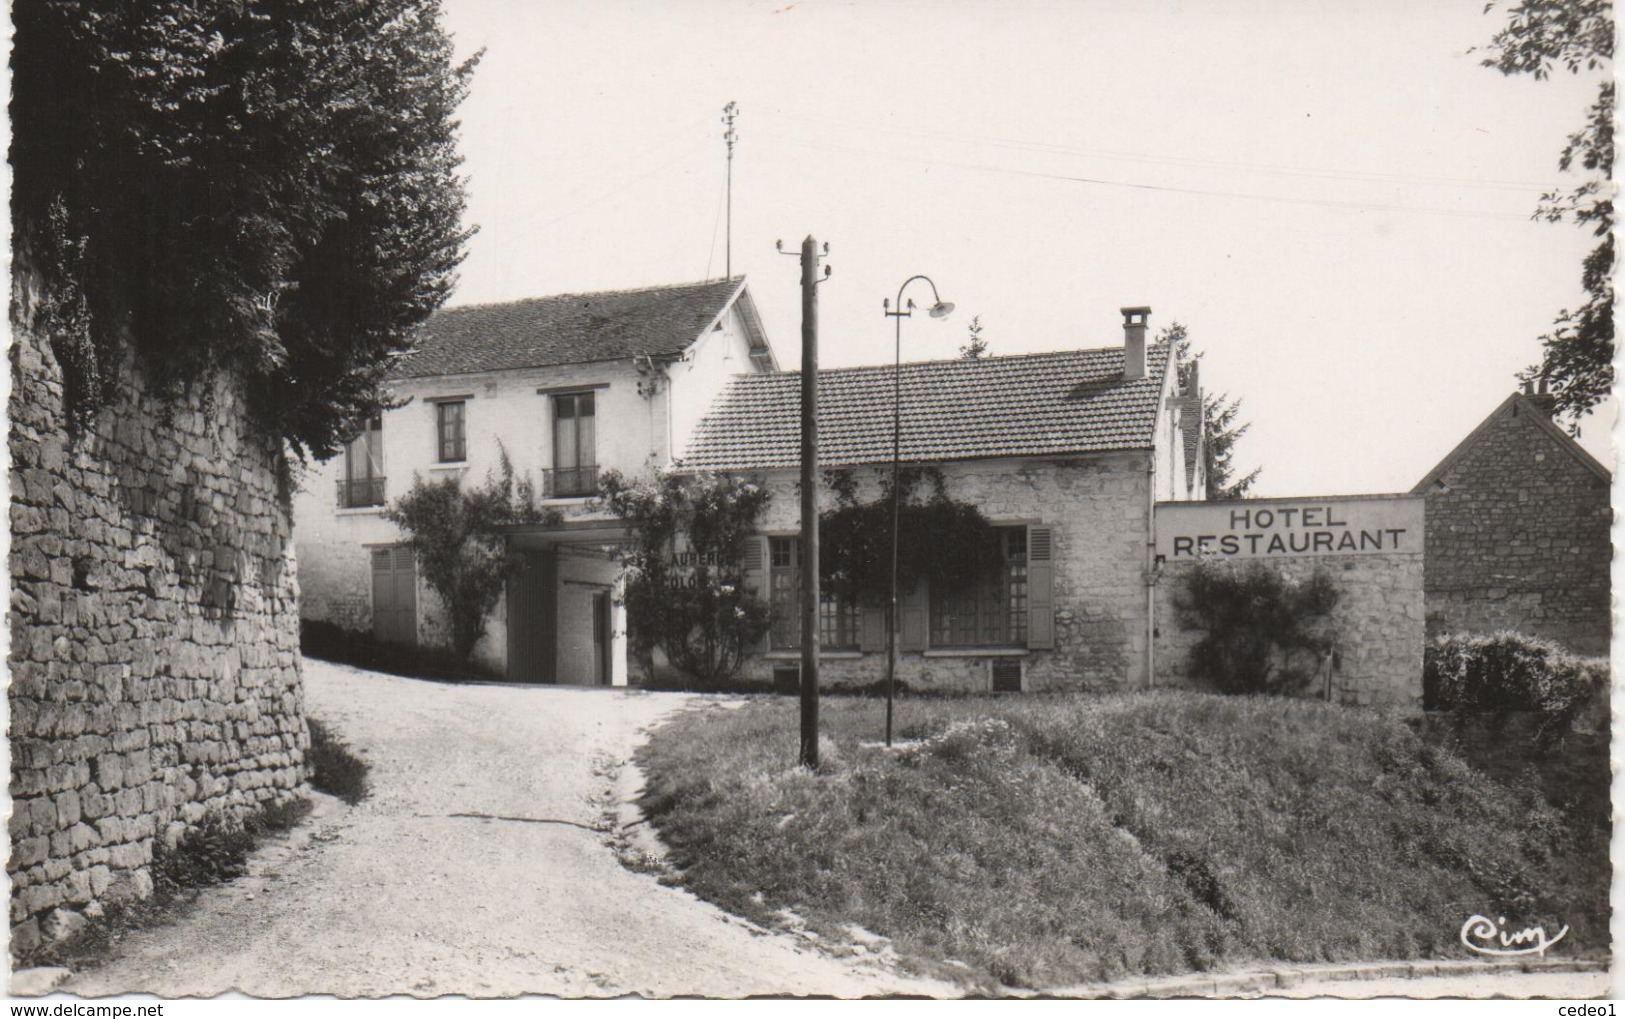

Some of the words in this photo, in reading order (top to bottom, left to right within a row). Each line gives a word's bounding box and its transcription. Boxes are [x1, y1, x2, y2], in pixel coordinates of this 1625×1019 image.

[1230, 507, 1347, 529] HOTEL
[1173, 528, 1406, 557] RESTAURANT
[671, 552, 733, 566] AUBERG
